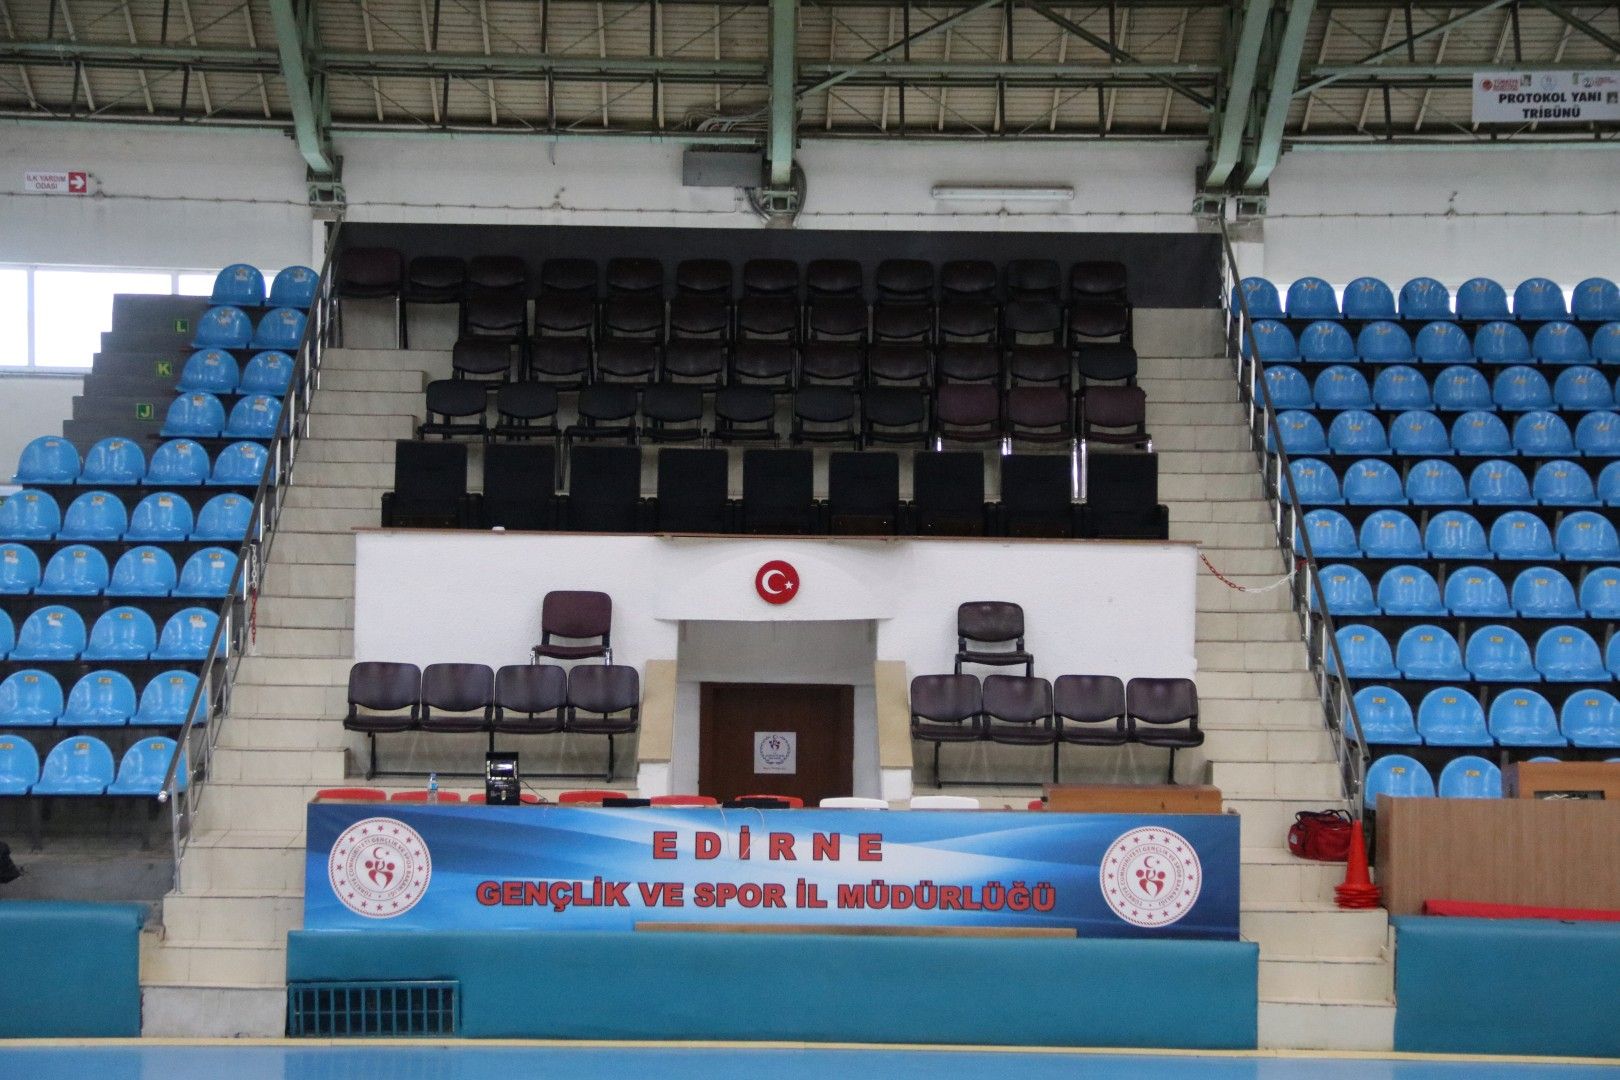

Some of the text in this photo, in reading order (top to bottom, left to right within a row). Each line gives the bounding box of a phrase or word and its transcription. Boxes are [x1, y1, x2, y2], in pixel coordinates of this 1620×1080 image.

[1499, 92, 1602, 104] PROTOKOL YANI
[1522, 105, 1581, 119] TRİBÜNÜ
[176, 320, 186, 332] L
[158, 363, 170, 375] K
[140, 405, 150, 418] J
[476, 876, 1056, 912] GENÇLİK VE SPOR İL MÜDÜRLÜĞÜ
